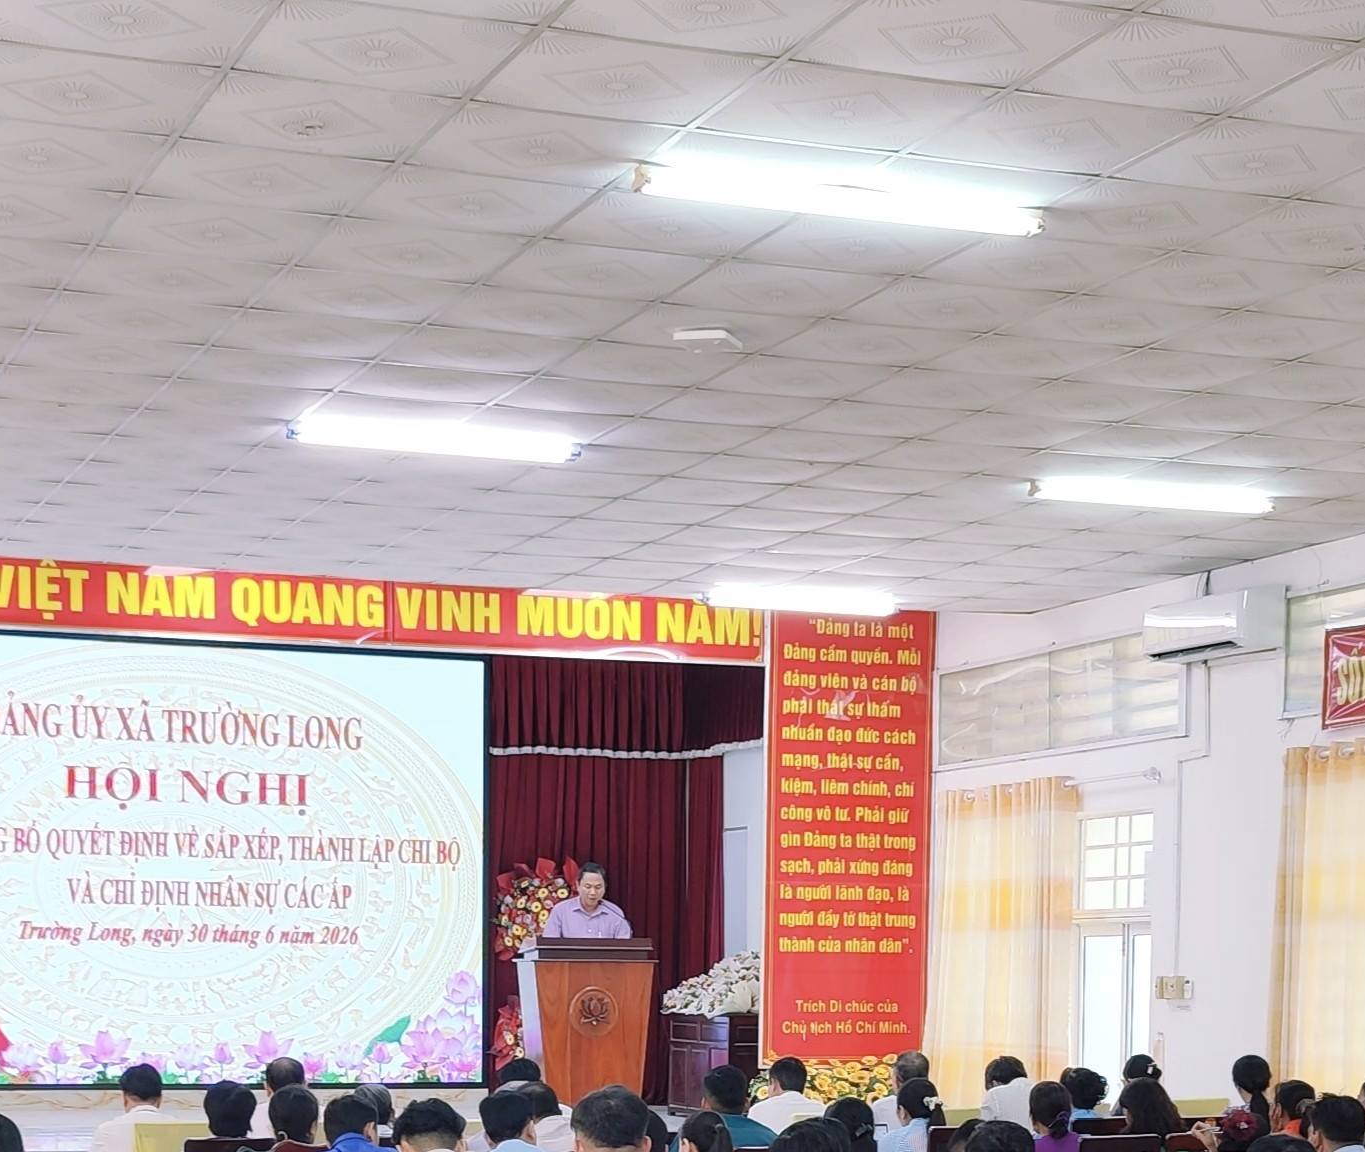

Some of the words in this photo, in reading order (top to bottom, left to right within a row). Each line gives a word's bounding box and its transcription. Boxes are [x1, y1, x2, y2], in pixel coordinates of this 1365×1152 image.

[106, 571, 216, 619] NAM
[230, 577, 385, 628] QUANG
[395, 587, 501, 634] VINH
[517, 593, 642, 641] MUÔN
[854, 620, 866, 637] ta
[871, 621, 883, 637] là
[888, 623, 914, 642] một
[783, 669, 816, 689] đảng
[820, 673, 848, 689] viên
[852, 674, 867, 690] và
[872, 675, 896, 691] cán
[901, 676, 916, 695] bộ
[71, 694, 109, 740] ỦY
[116, 698, 155, 742] XÃ
[162, 702, 280, 747] TRƯỜNG
[288, 714, 364, 751] LONG
[64, 762, 162, 810] HỘI
[179, 769, 311, 816] NGHỊ
[781, 777, 816, 796] kiệm,
[821, 779, 849, 795] liêm
[853, 781, 891, 798] chính,
[13, 820, 40, 853] BỐ
[47, 822, 115, 860] QUYẾT
[120, 830, 169, 863] ĐỊNH
[174, 825, 199, 859] VỀ
[205, 826, 240, 859] SẮP
[244, 827, 283, 865] XẾP,
[287, 829, 355, 862] THÀNH
[359, 834, 394, 869] LẬP
[399, 839, 432, 864] CHI
[435, 836, 460, 871] BỘ
[780, 831, 800, 848] gìn
[804, 830, 836, 849] Đảng
[840, 833, 852, 848] ta
[856, 833, 880, 851] thật
[884, 834, 916, 851] trong
[67, 870, 96, 904] VÀ
[101, 872, 137, 904] CHỈ
[141, 880, 190, 912] ĐỊNH
[195, 875, 249, 908] NHÂN
[254, 878, 281, 914] SỰ
[284, 876, 324, 909] CÁC
[19, 920, 82, 946] Trường
[87, 921, 136, 946] Long,
[141, 922, 183, 947] ngày
[187, 923, 208, 943] 30
[212, 925, 261, 949] tháng
[265, 925, 275, 944] 6
[279, 928, 315, 945] năm
[320, 926, 360, 945] 2026
